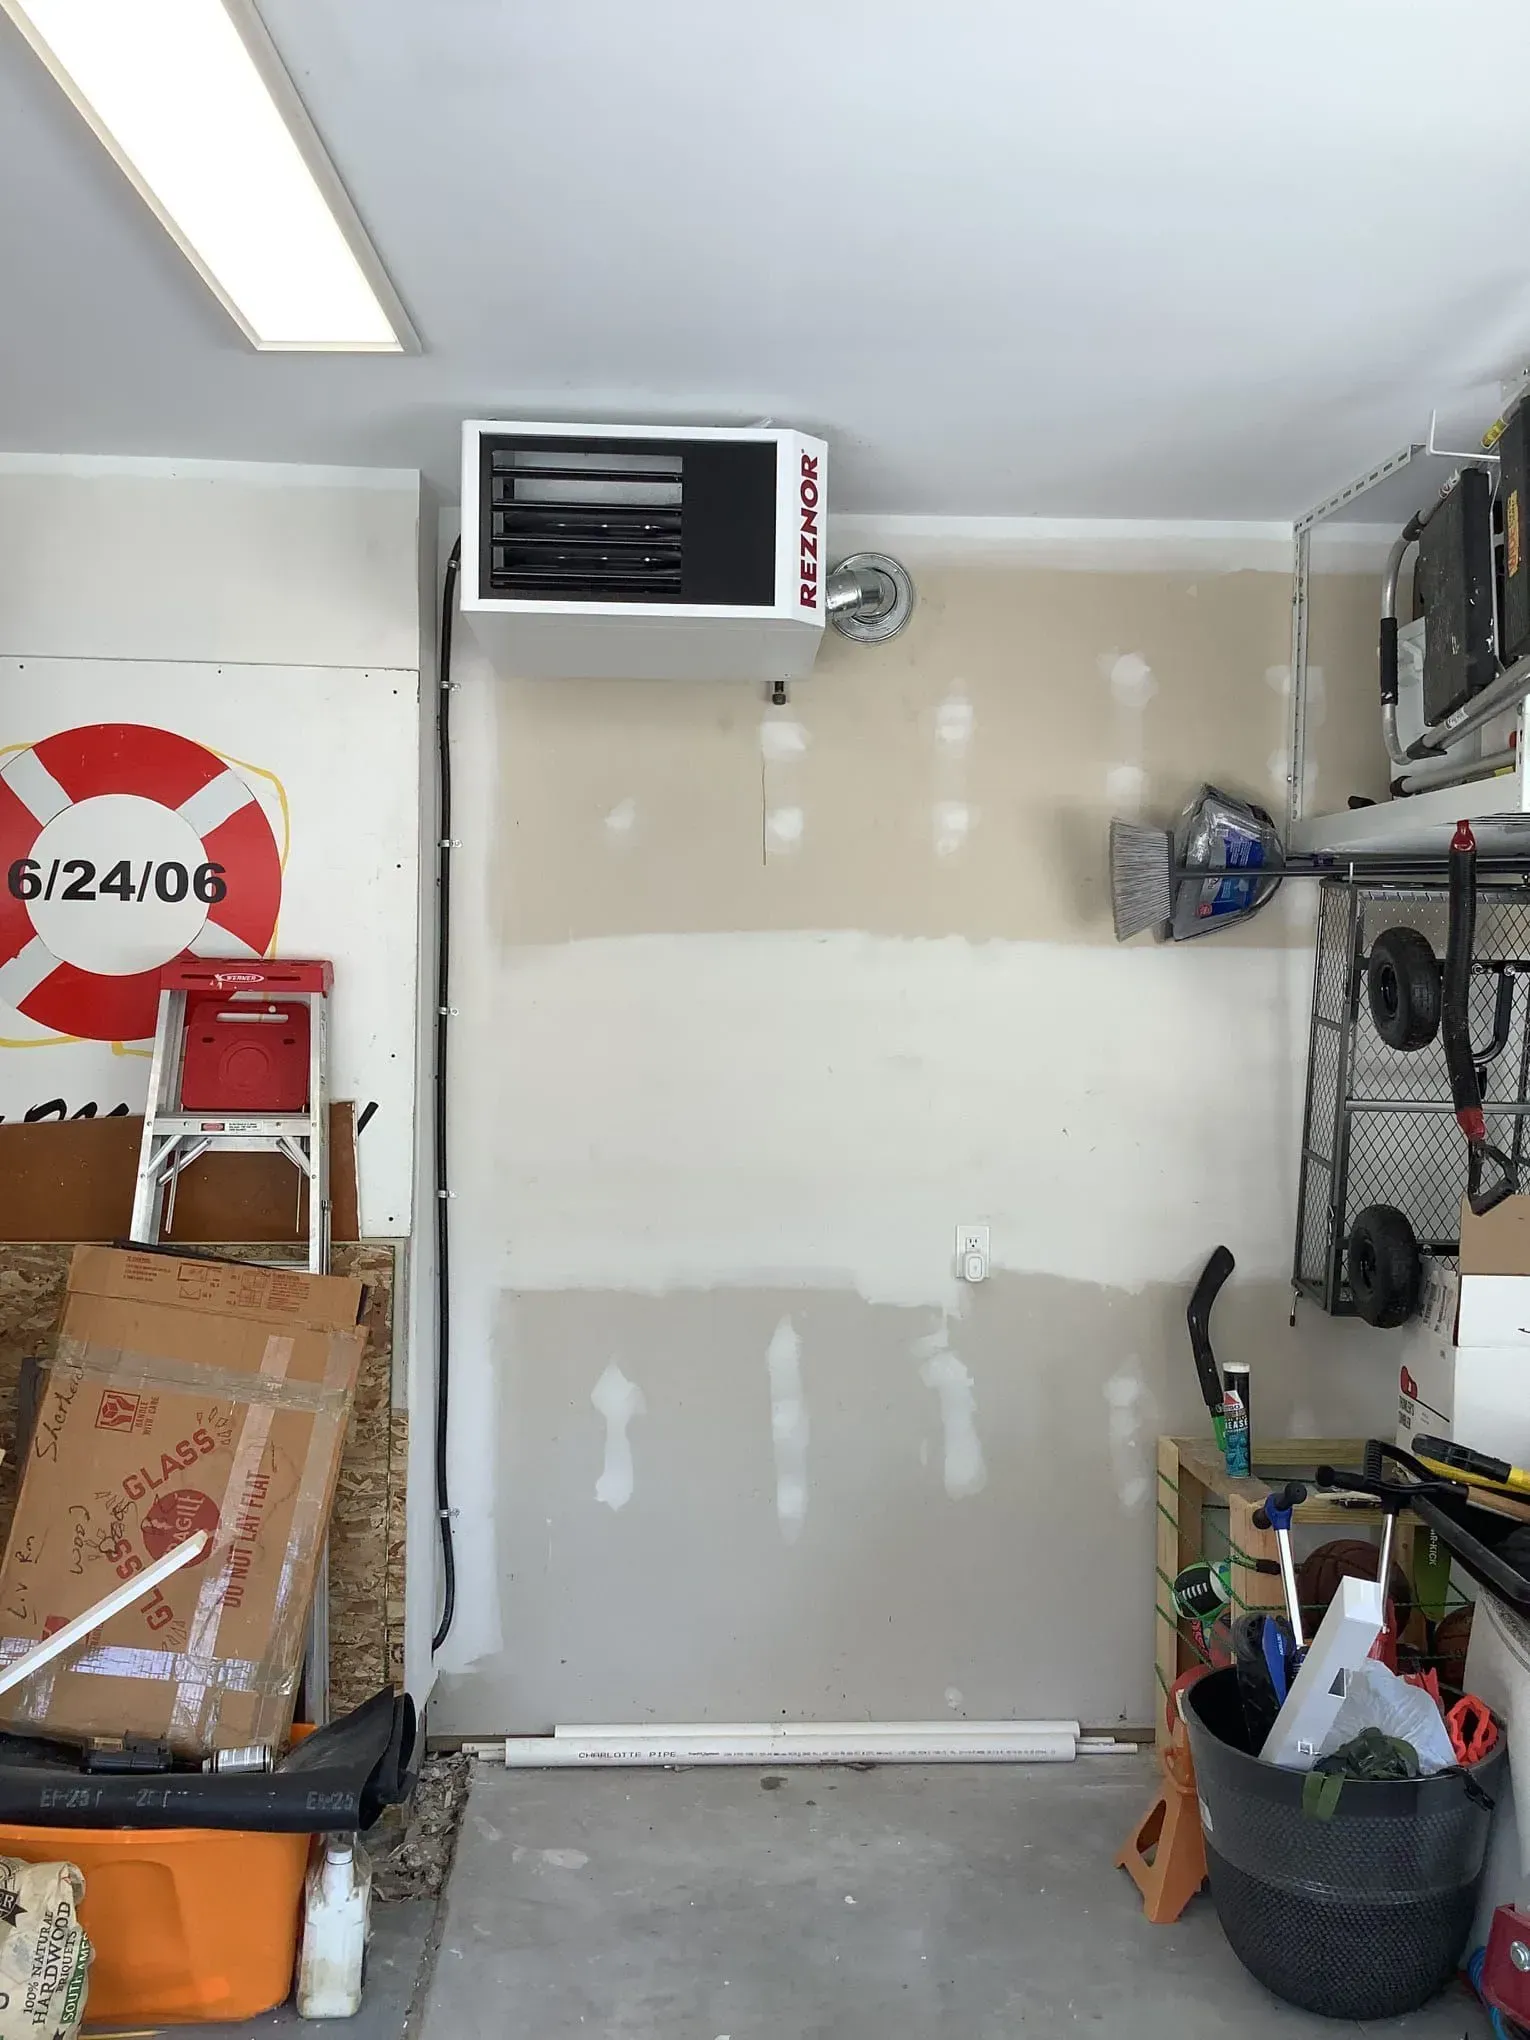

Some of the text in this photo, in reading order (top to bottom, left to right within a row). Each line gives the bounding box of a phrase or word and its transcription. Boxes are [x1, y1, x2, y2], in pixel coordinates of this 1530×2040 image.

[800, 454, 818, 608] REZNOR
[7, 858, 228, 903] 6/24/06
[149, 1395, 160, 1418] CARE
[122, 1428, 215, 1500] GLASS
[167, 1493, 206, 1552] AGILE
[106, 1538, 174, 1631] GLSS
[578, 1751, 642, 1759] CHARLOTTE
[23, 1911, 54, 2014] 100% NATURAL
[32, 1901, 71, 2026] HARDWOOD
[56, 1931, 77, 1993] BRIQUETS
[62, 1974, 84, 2022] SOUTH
